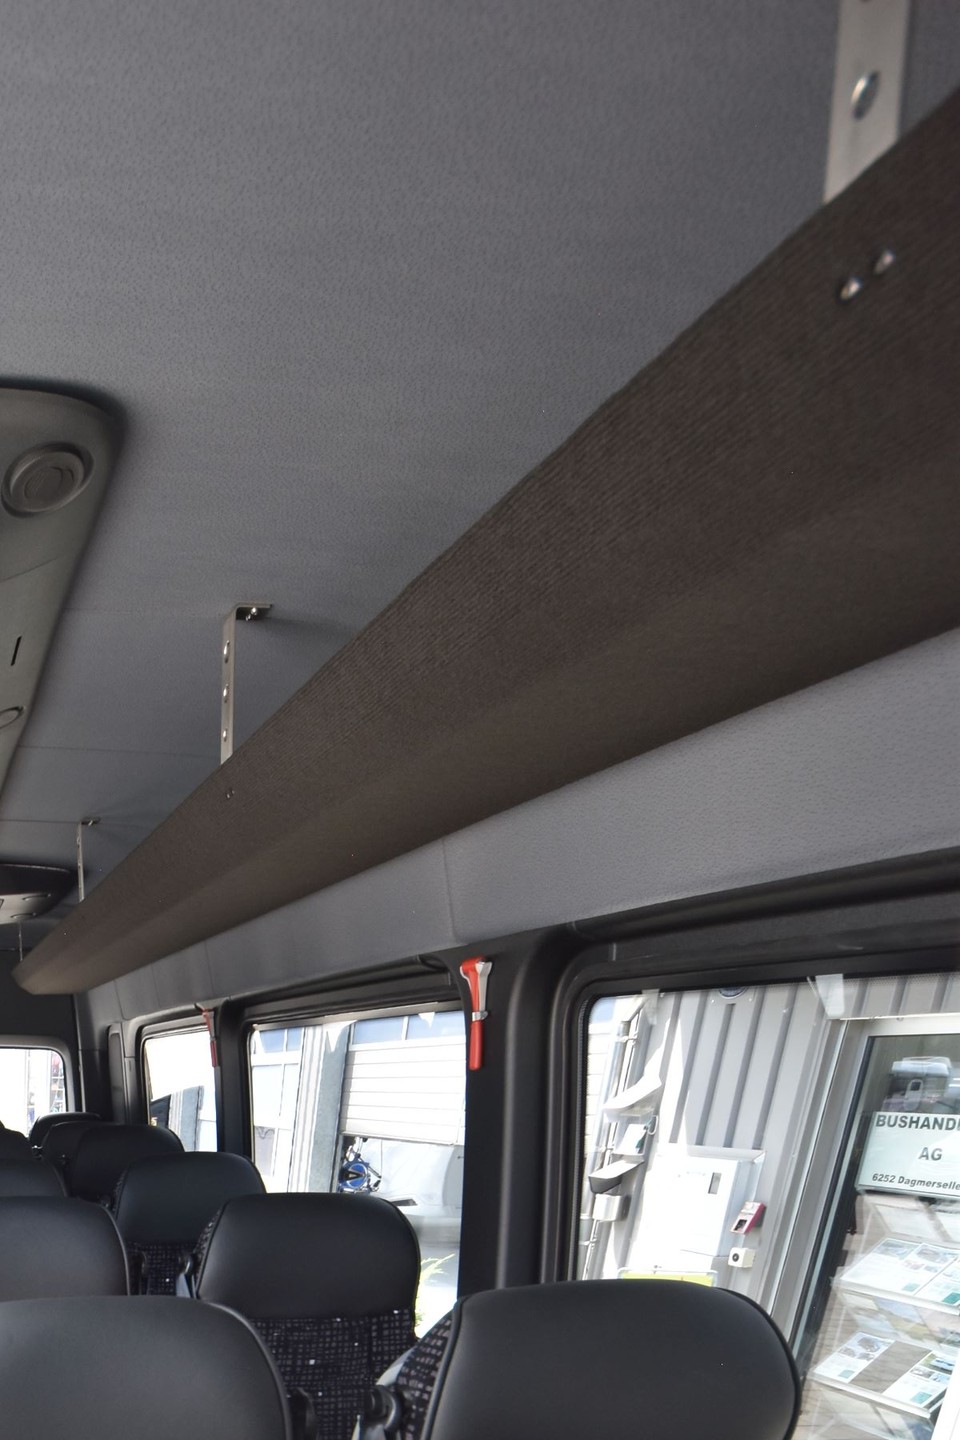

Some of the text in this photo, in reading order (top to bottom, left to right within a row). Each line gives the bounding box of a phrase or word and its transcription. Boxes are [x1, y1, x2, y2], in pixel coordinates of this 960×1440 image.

[876, 1114, 960, 1131] BUSHAND
[918, 1147, 942, 1161] AG
[872, 1173, 896, 1183] 6252
